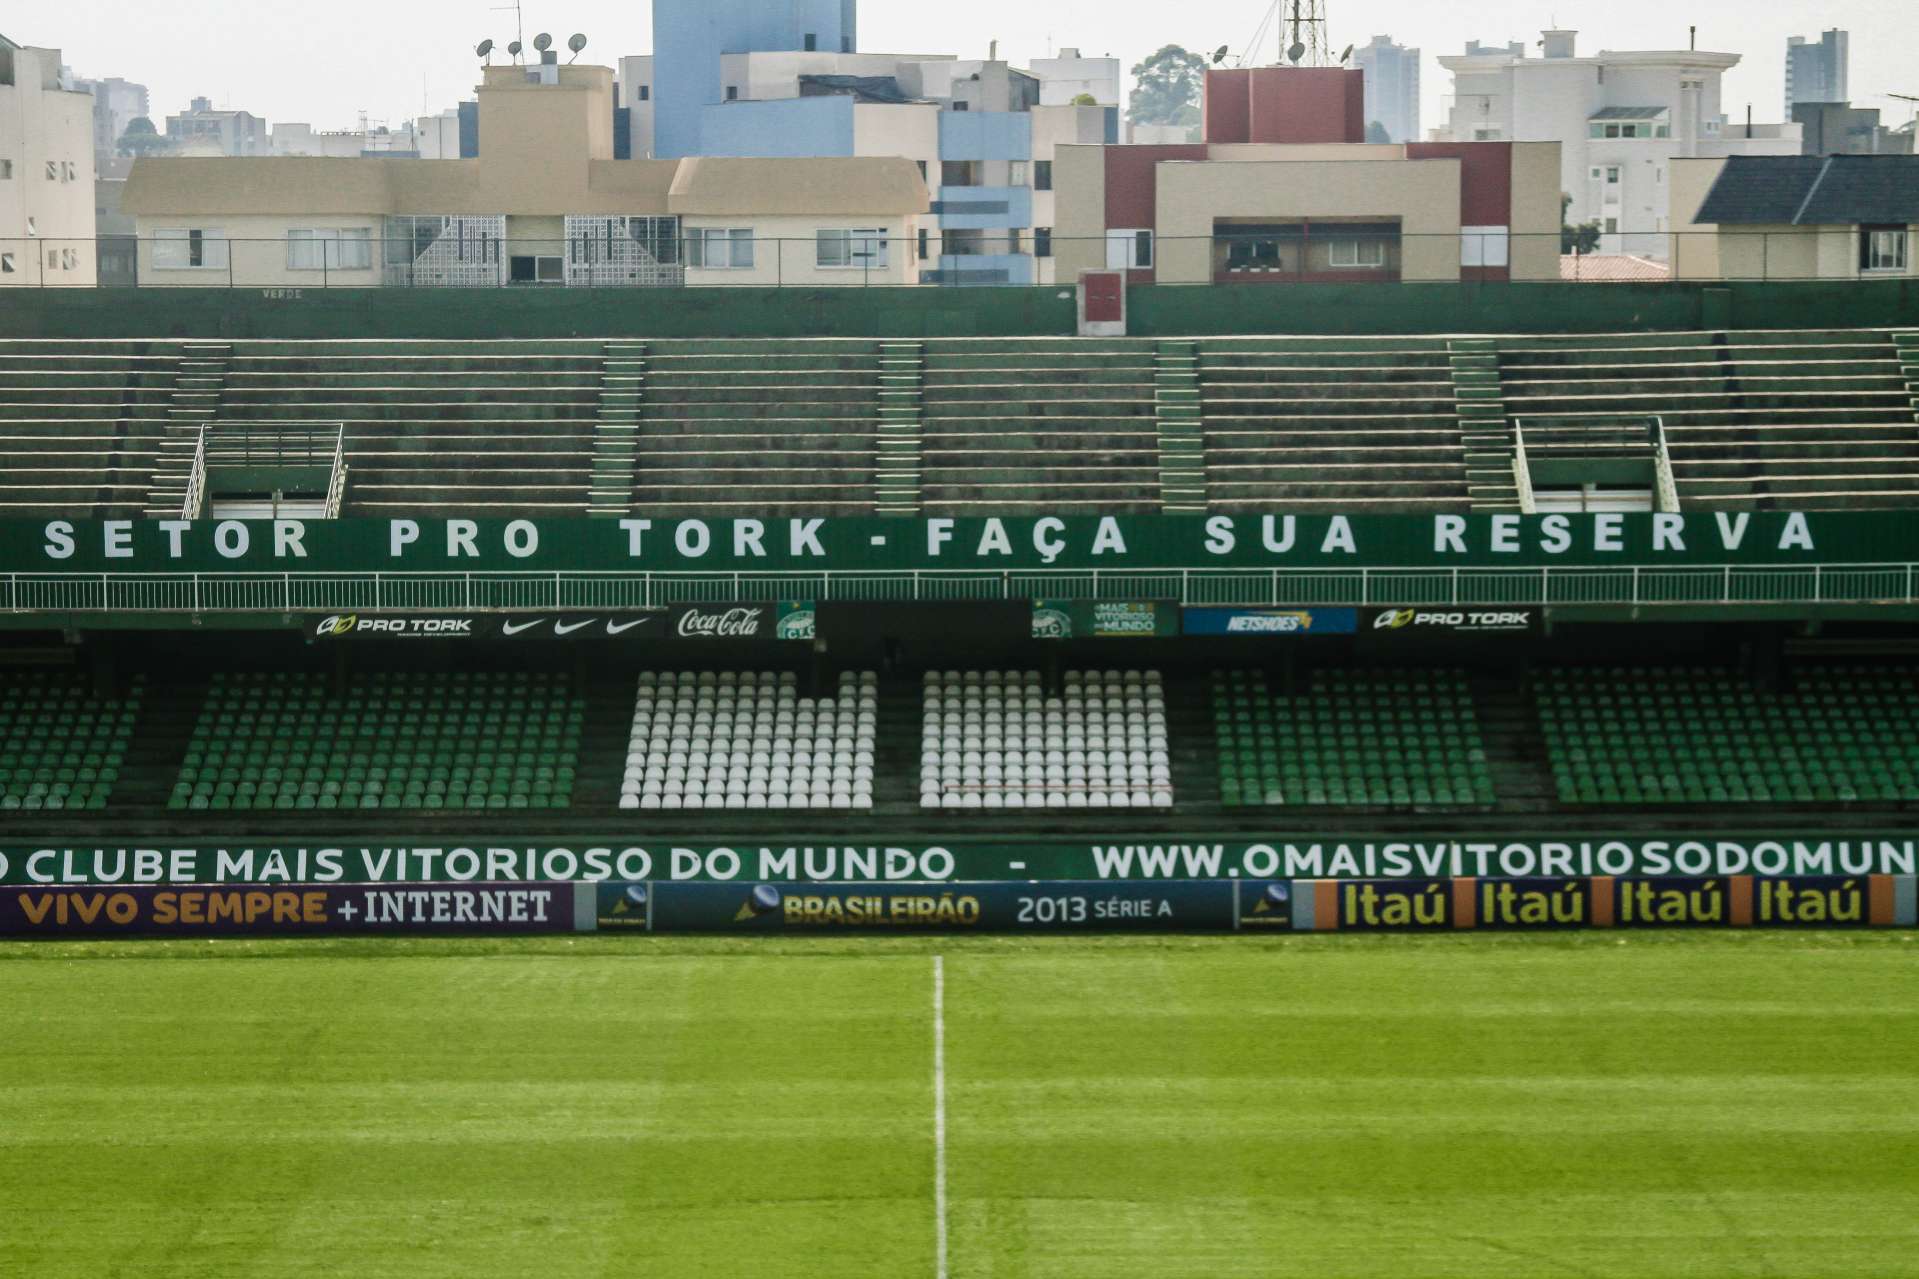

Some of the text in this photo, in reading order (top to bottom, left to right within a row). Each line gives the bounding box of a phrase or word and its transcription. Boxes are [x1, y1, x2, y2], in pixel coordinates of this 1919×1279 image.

[44, 520, 308, 559] SETOR
[390, 519, 539, 558] PRO
[619, 518, 826, 558] TORK
[927, 516, 1127, 564] FAÇA
[1204, 514, 1356, 554] SUA
[1434, 511, 1814, 554] RESERVA
[357, 619, 472, 631] PRO TORK
[678, 608, 762, 637] Coca-Cola
[1227, 616, 1299, 632] NETSHOES
[1415, 612, 1530, 624] PRO TORK
[25, 849, 197, 883] CLUBE
[216, 848, 344, 882] MAIS
[360, 848, 652, 882] VITORIOSO
[670, 847, 741, 881] DO
[759, 847, 955, 880] MUNDO
[19, 893, 138, 924] VIVO
[152, 891, 328, 924] SEMPRE
[783, 892, 1173, 924] BRASILEIRÃO 2013 SÉRIE A
[1346, 884, 1445, 925] Itaú
[1484, 883, 1582, 923] Itaú
[1622, 881, 1722, 922] Itaú
[1761, 880, 1861, 921] Itaú
